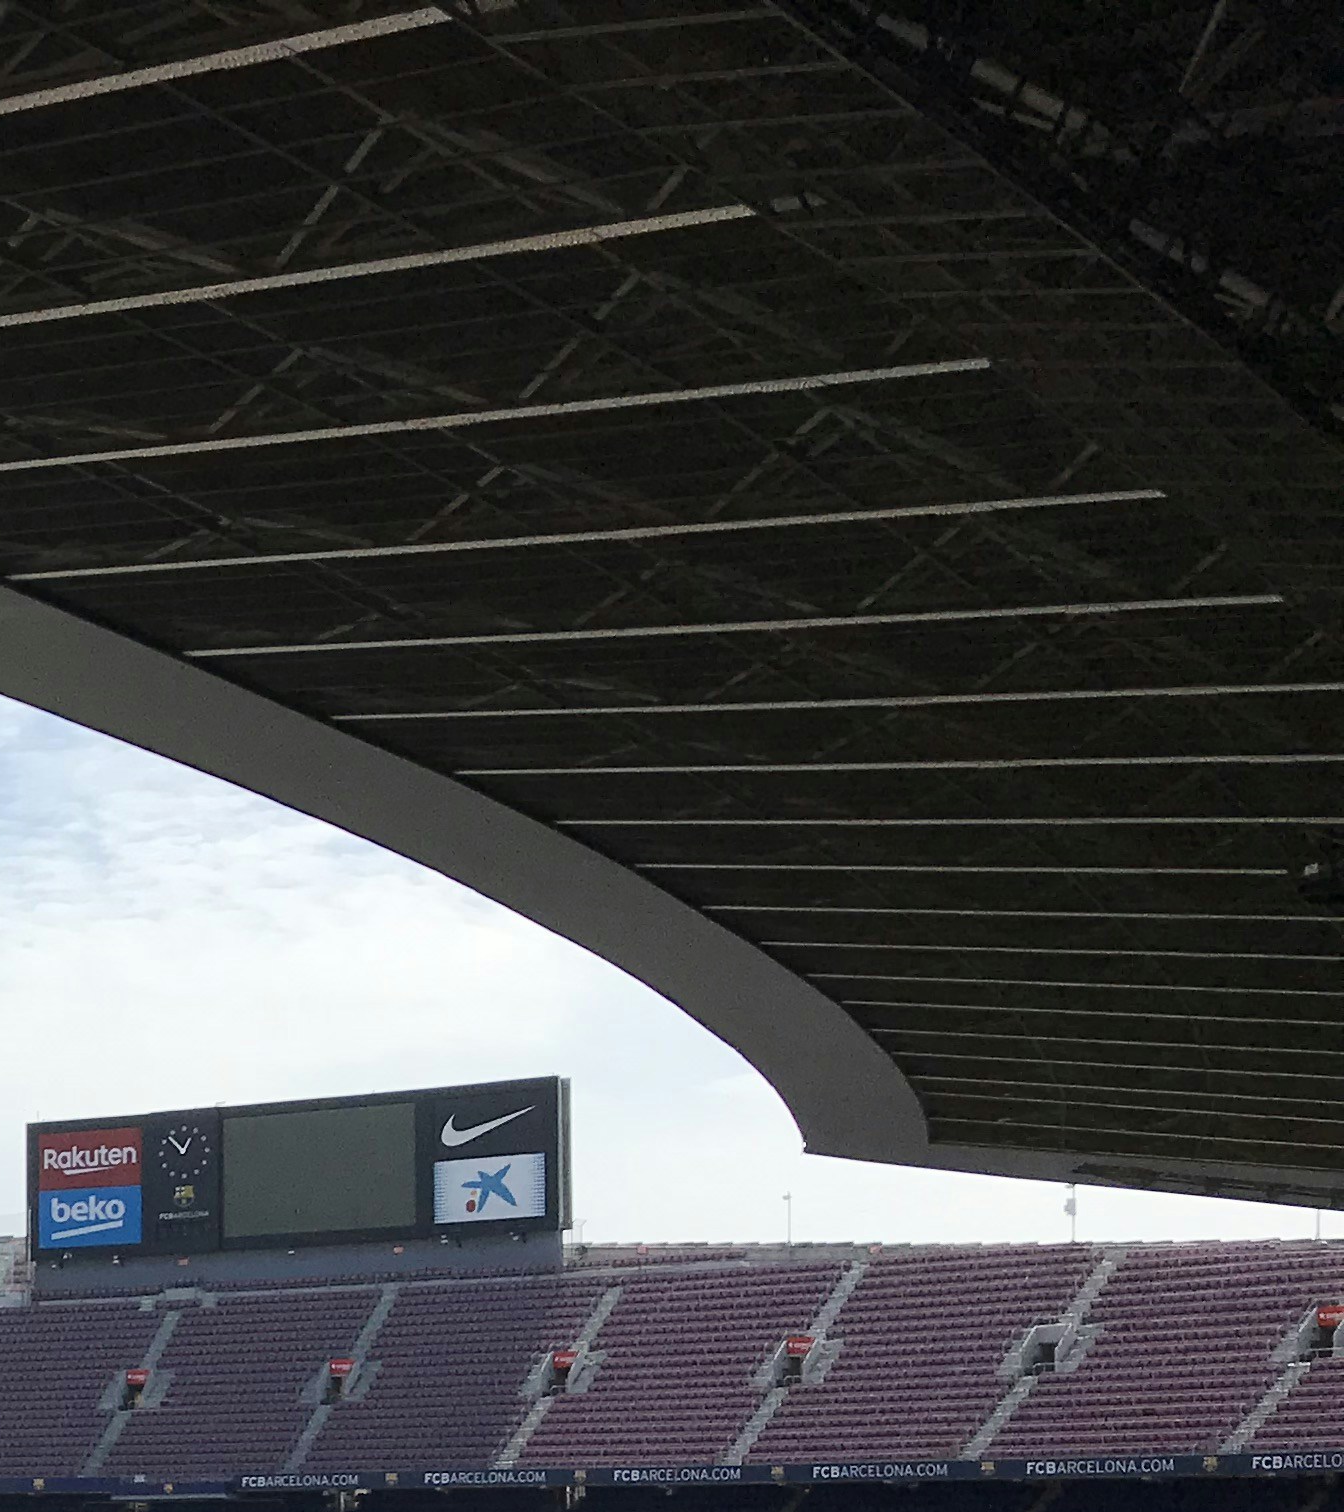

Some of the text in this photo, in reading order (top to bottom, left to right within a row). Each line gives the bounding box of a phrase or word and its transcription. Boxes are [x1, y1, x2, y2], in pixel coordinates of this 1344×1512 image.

[43, 1145, 138, 1170] Rakuten
[51, 1195, 126, 1223] beko
[812, 1464, 948, 1480] FCBARCELONA.COM
[1026, 1458, 1174, 1475] FCBARCELONA.COM
[241, 1474, 359, 1488] FCBARCELONA.COM
[424, 1471, 546, 1485] FCBARCELONA.COM
[613, 1468, 741, 1482] FCBARCELONA.COM
